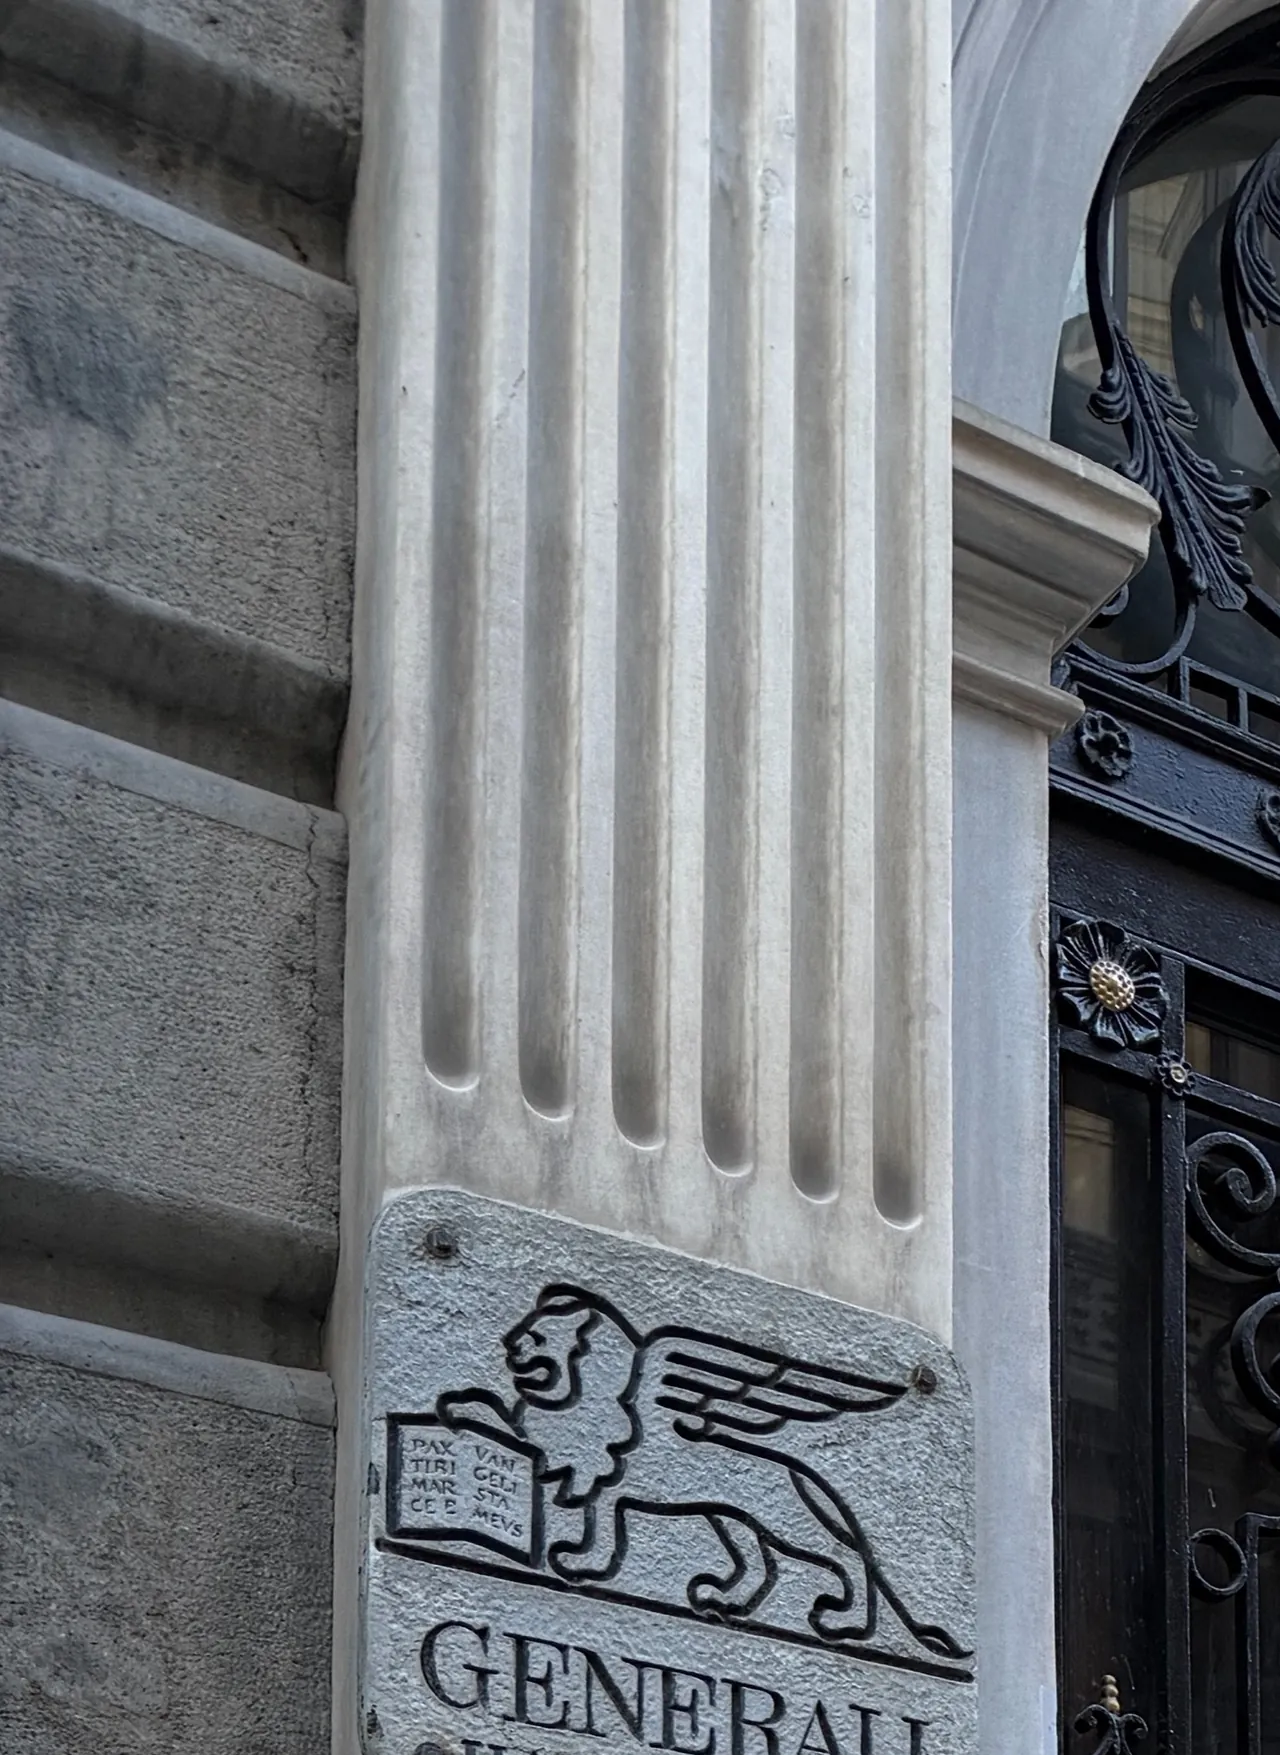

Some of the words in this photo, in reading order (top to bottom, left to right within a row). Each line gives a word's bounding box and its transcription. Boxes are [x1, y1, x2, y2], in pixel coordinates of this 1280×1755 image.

[411, 1439, 458, 1457] PAX
[475, 1446, 517, 1473] VAN
[411, 1478, 462, 1496] MAR
[473, 1466, 518, 1495] GELI
[473, 1487, 510, 1511] STA
